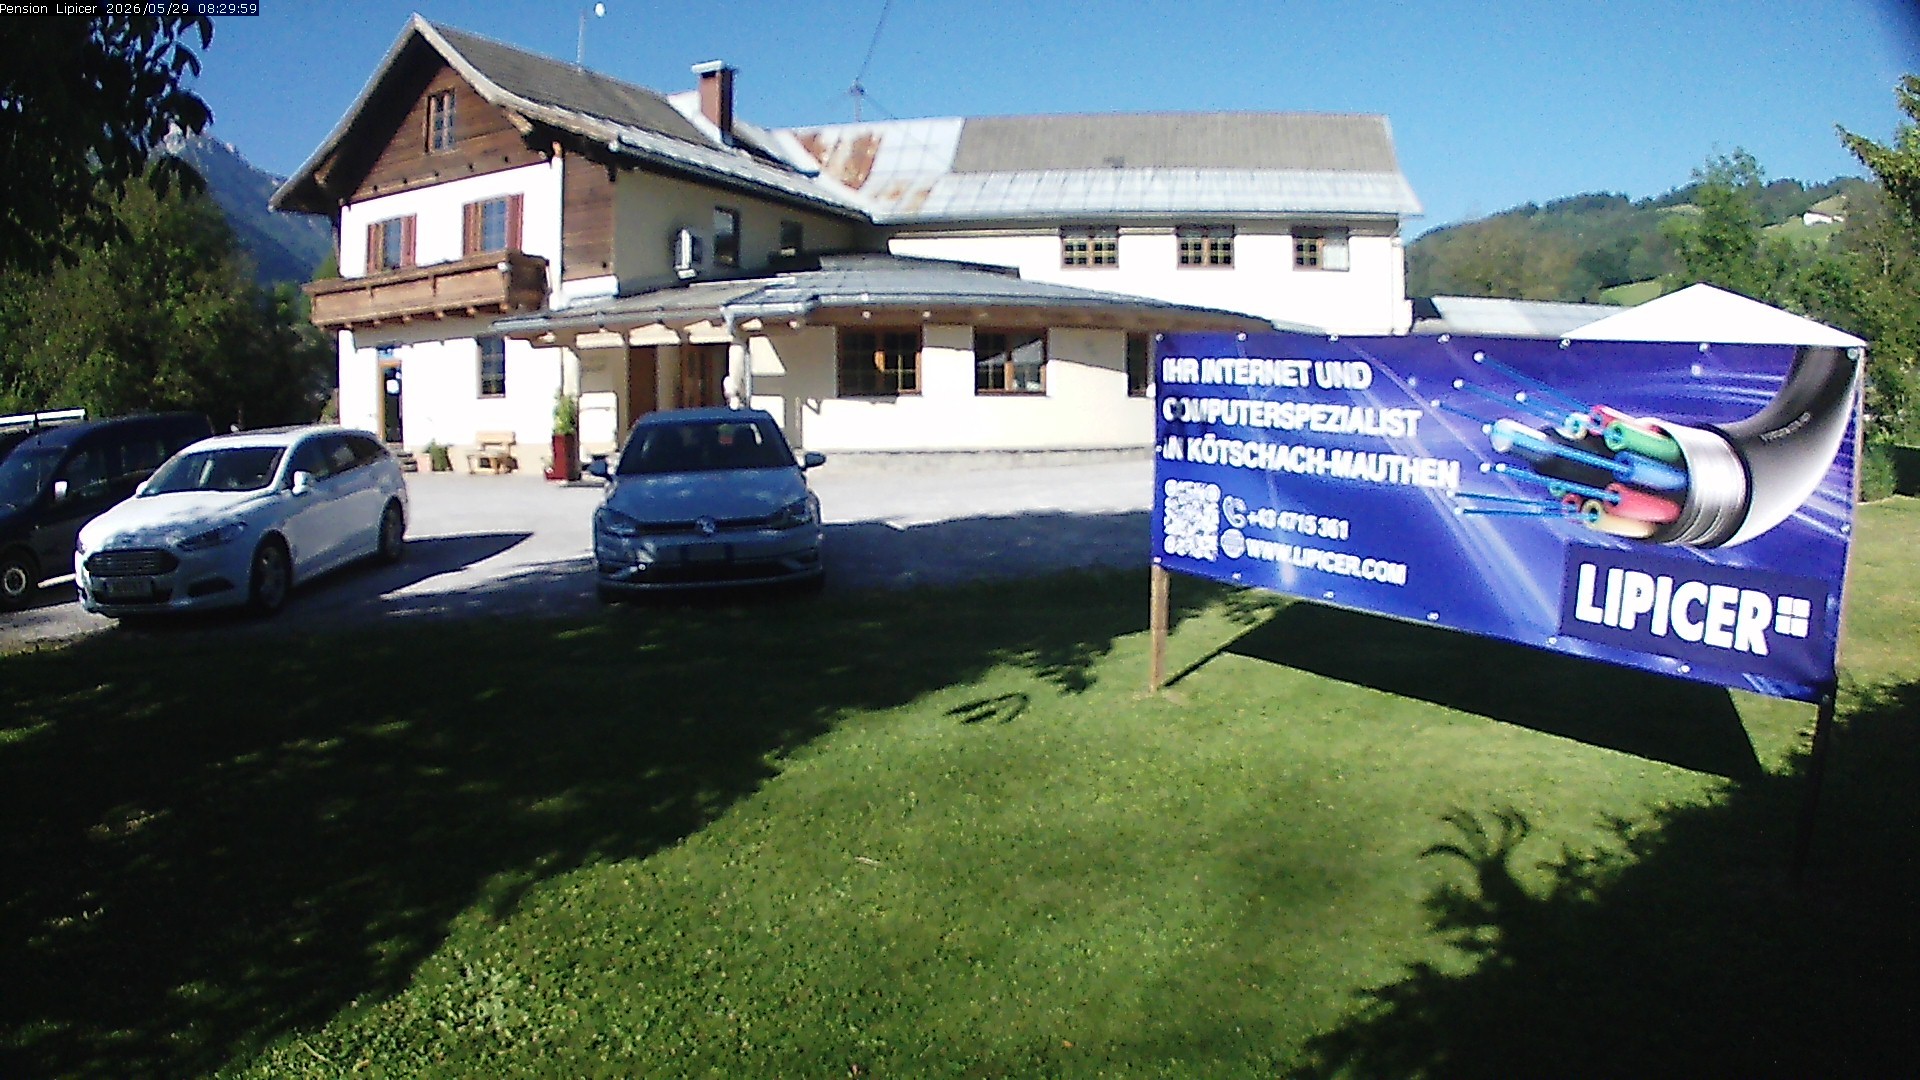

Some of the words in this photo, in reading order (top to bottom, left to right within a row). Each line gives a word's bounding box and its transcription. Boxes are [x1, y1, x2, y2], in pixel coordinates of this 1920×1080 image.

[1162, 357, 1199, 384] IHR
[1201, 357, 1312, 388] INTERNET
[1315, 361, 1373, 391] UND
[1162, 396, 1423, 438] COMPUTERSPEZIALIST
[1187, 432, 1461, 488] KÖTSCHACH-MAUTHEN
[1245, 537, 1408, 586] WWW.LIPICER.COM
[1574, 562, 1774, 657] LIPICER
